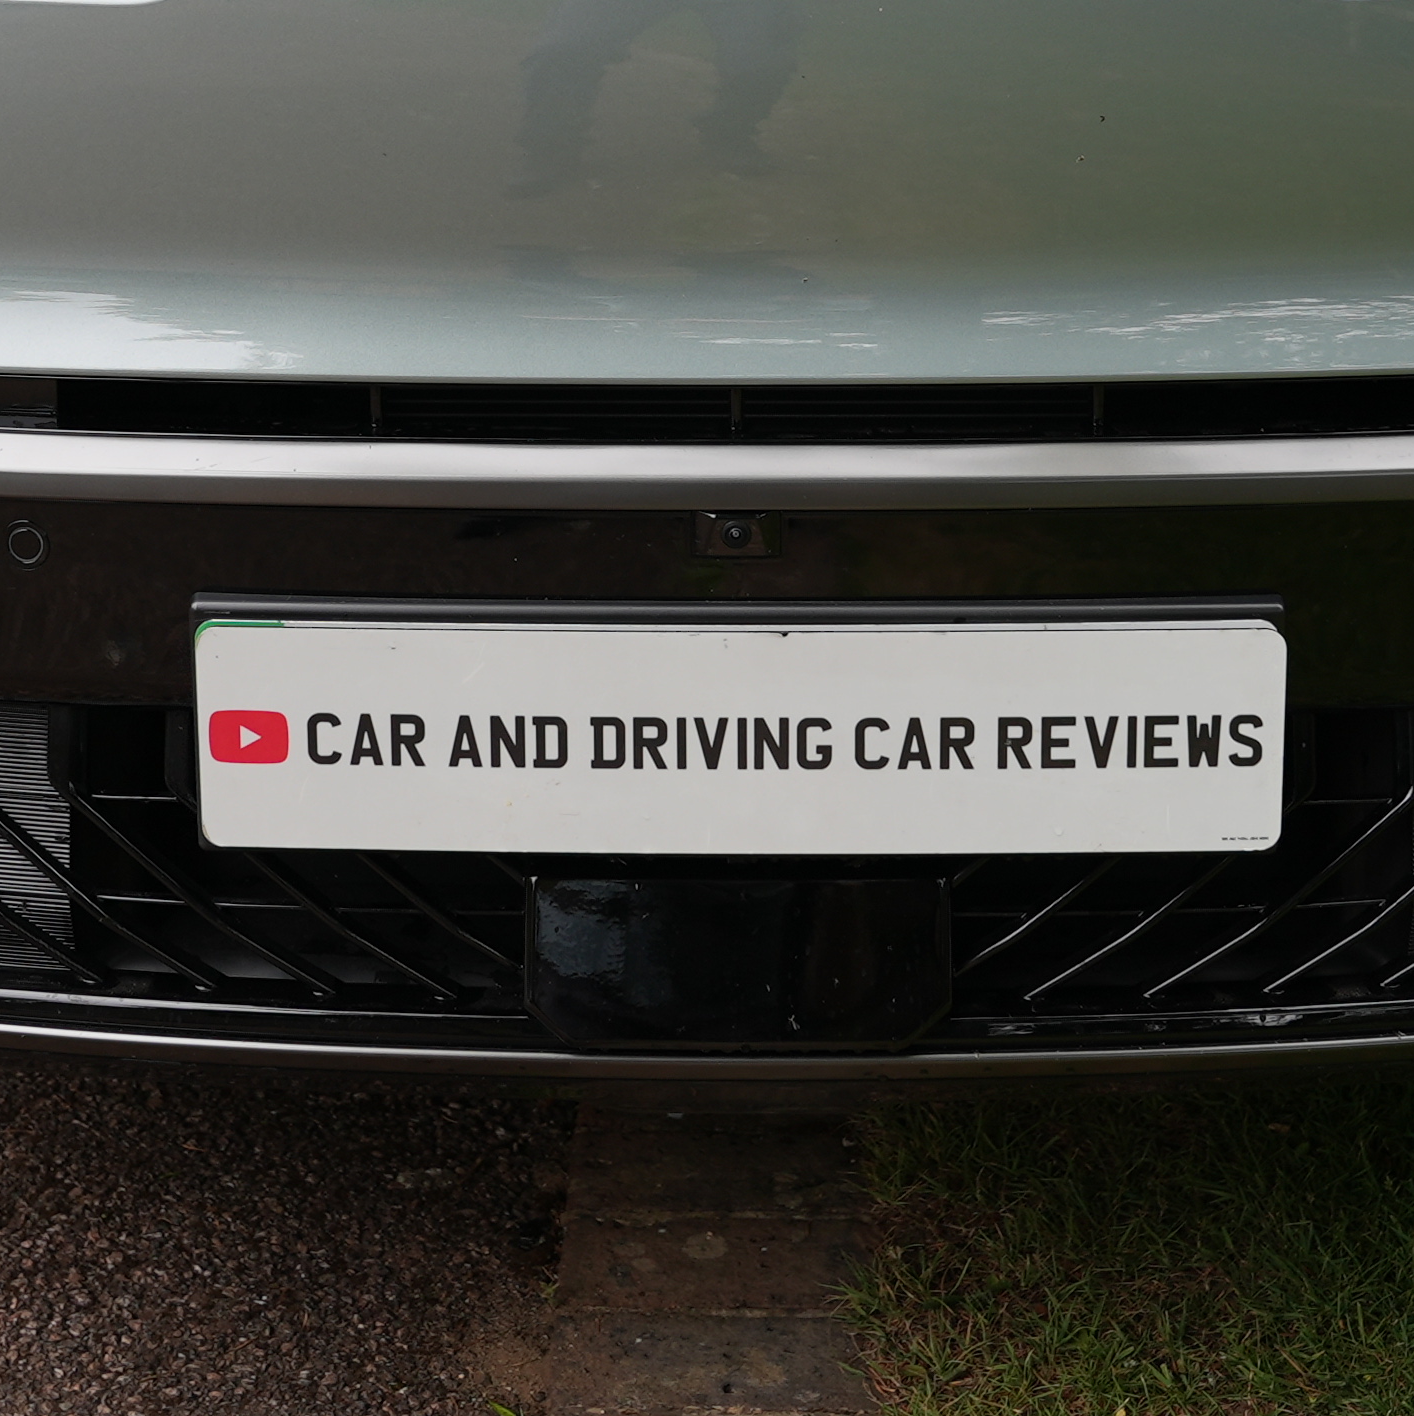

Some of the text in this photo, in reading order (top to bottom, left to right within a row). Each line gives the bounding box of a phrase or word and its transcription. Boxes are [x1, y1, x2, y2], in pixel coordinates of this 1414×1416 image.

[306, 712, 1264, 771] CAR AND DRIVING CAR REVIEWS
